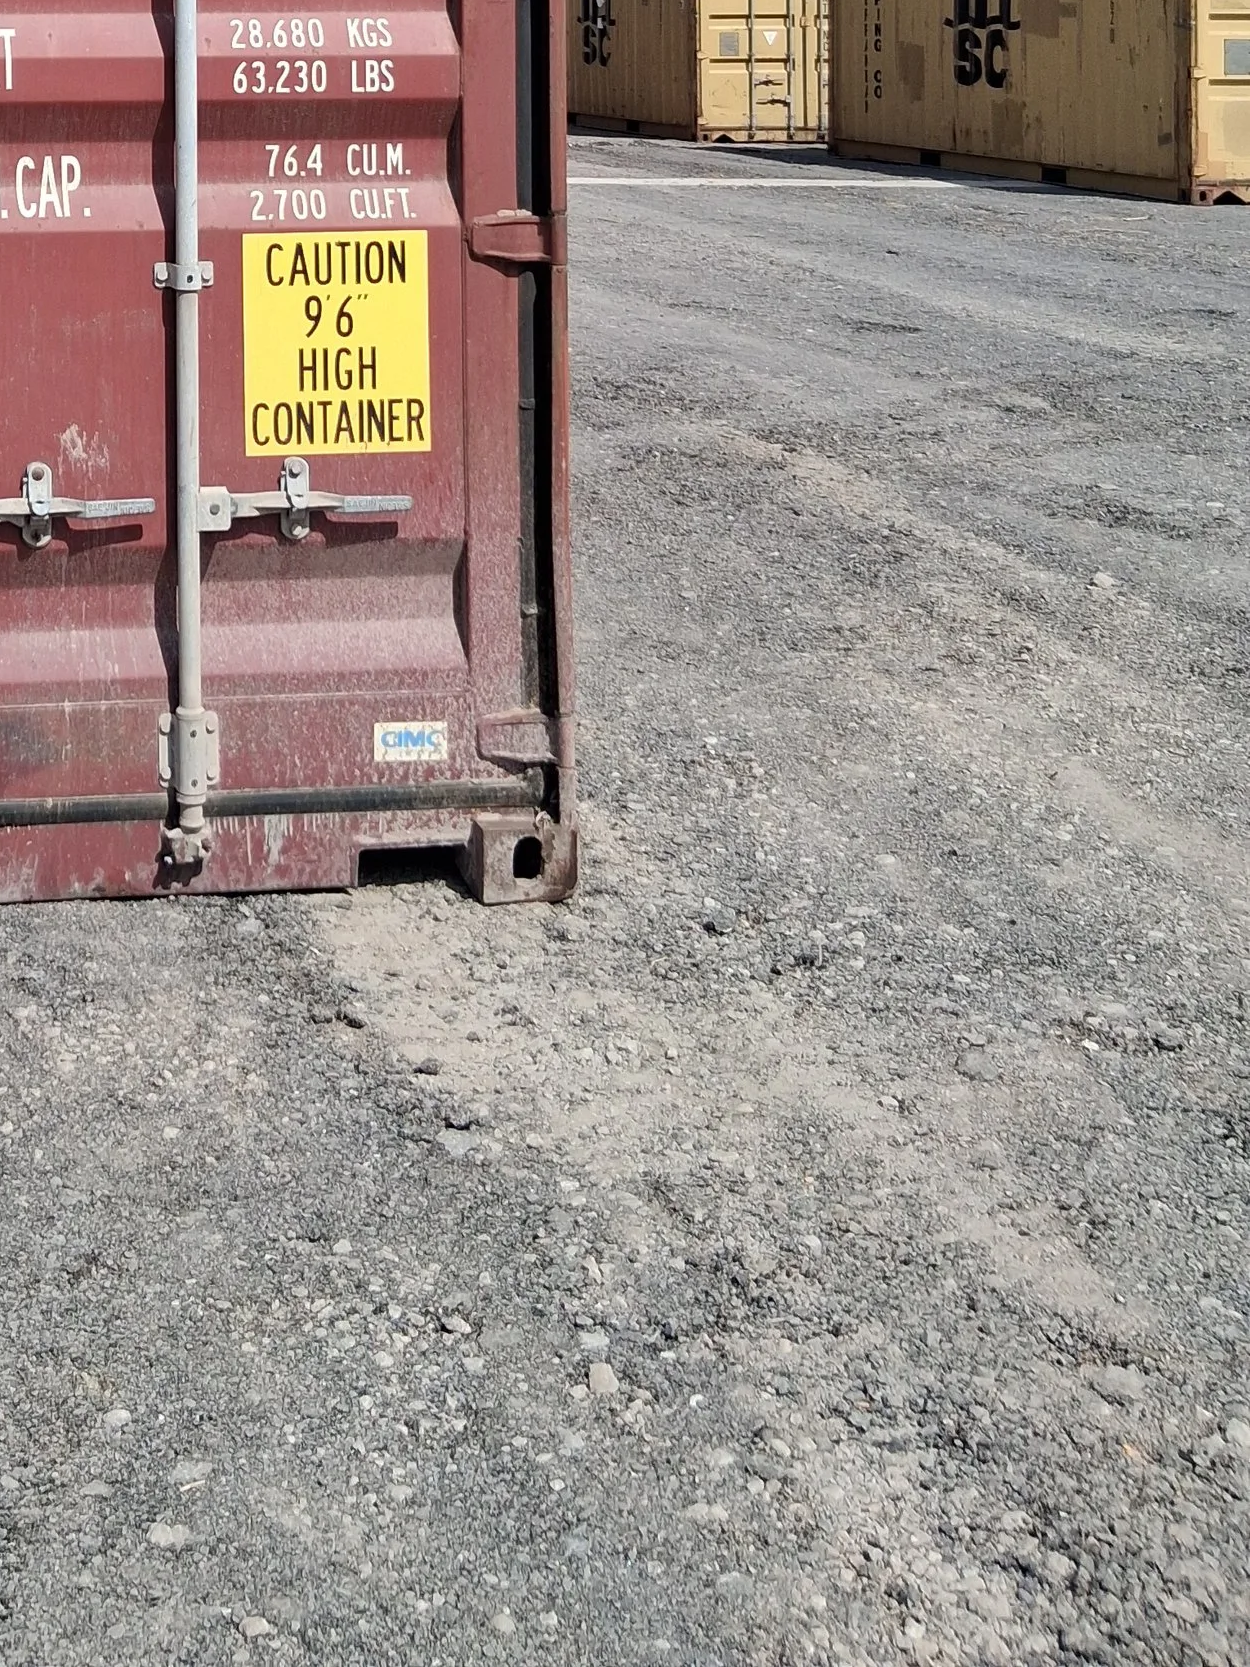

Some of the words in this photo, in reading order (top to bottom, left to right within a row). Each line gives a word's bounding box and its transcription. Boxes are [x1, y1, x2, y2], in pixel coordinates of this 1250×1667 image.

[345, 17, 393, 48] KGS
[232, 59, 328, 95] 63,230
[350, 58, 396, 94] LBS
[873, 69, 883, 100] CO
[264, 142, 324, 178] 76.4
[346, 141, 413, 177] CU.M.
[14, 154, 92, 219] CAP.
[348, 186, 418, 220] CU.FT.
[265, 239, 407, 288] CAUTION
[297, 345, 378, 393] HIGH
[251, 397, 426, 447] CONTAINER
[380, 729, 445, 749] CIMC
